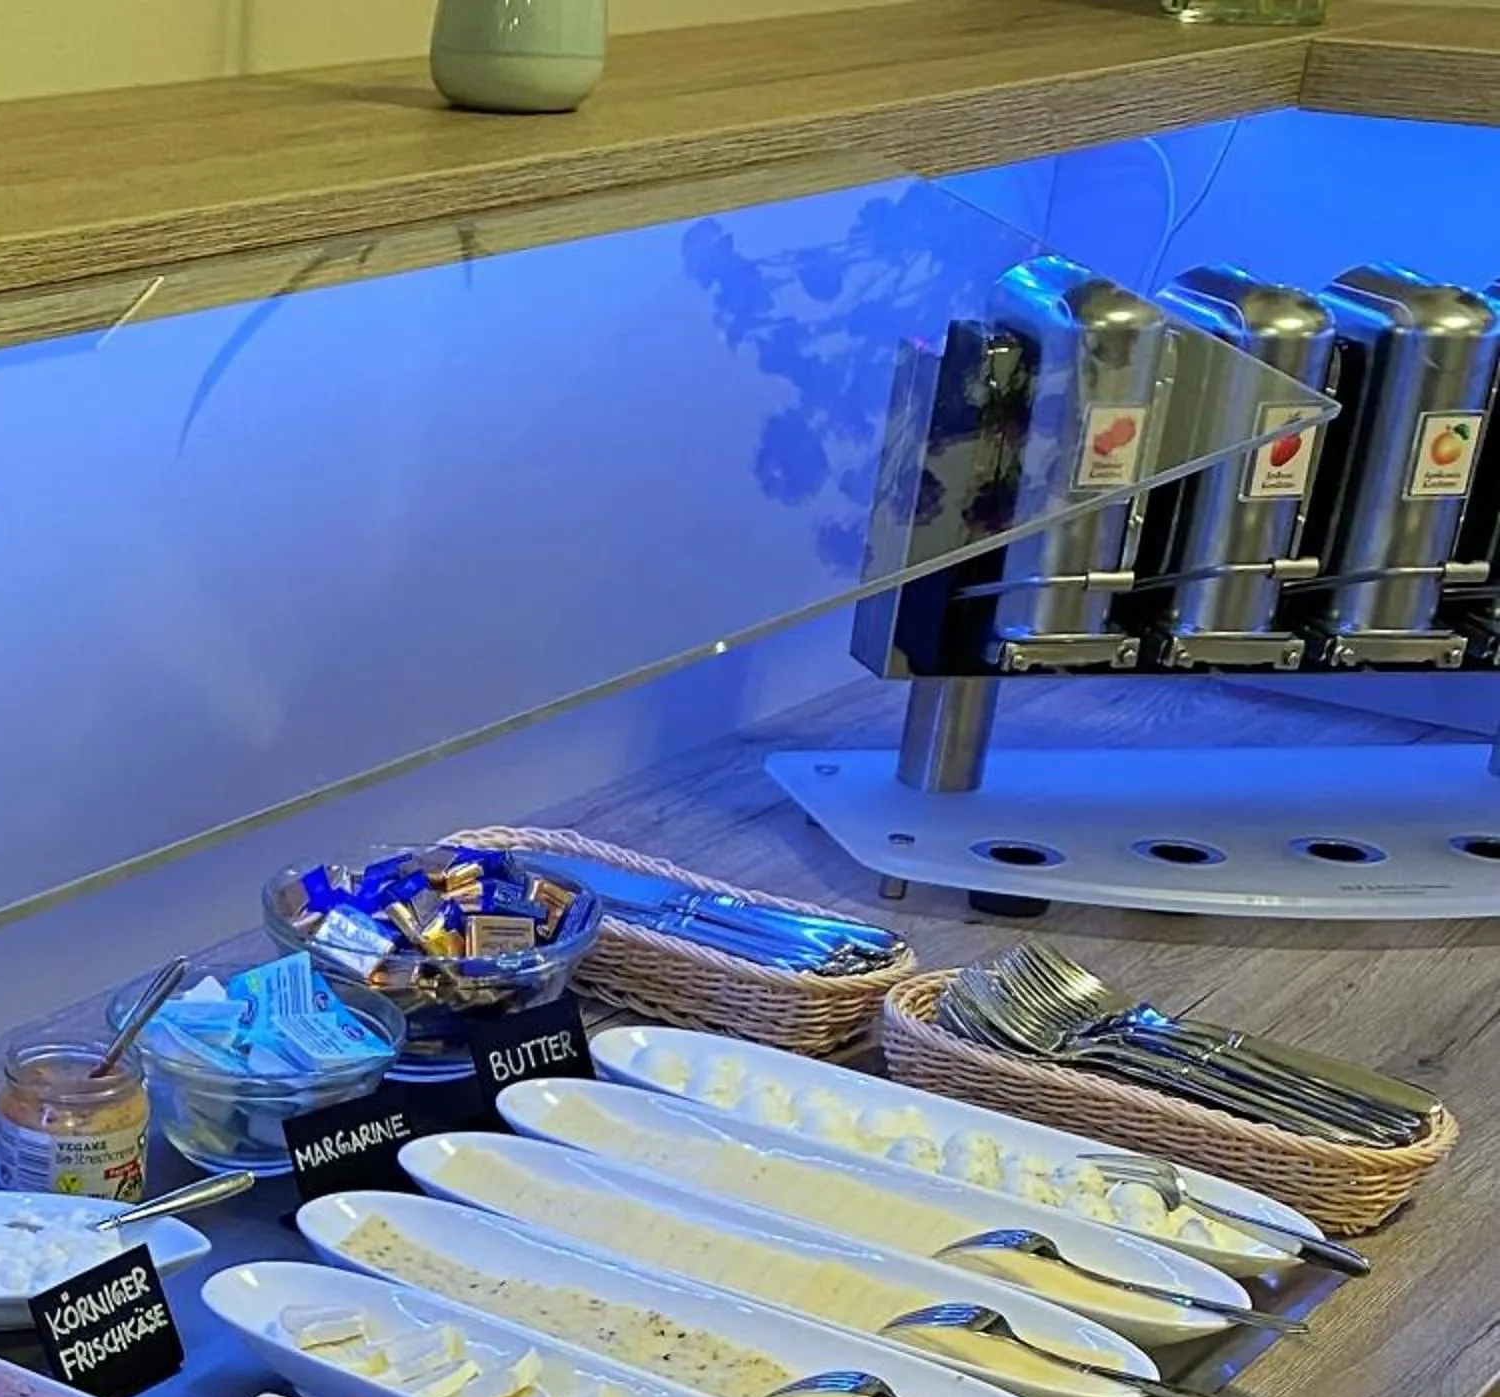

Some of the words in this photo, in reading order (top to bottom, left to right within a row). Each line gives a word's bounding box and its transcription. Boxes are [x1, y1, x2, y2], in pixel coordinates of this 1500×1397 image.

[489, 1030, 578, 1082] BUTTER
[295, 1114, 411, 1172] MARGARINE
[44, 1266, 150, 1342] KÖRNIGER
[59, 1303, 169, 1382] FRISCHKÄSE
